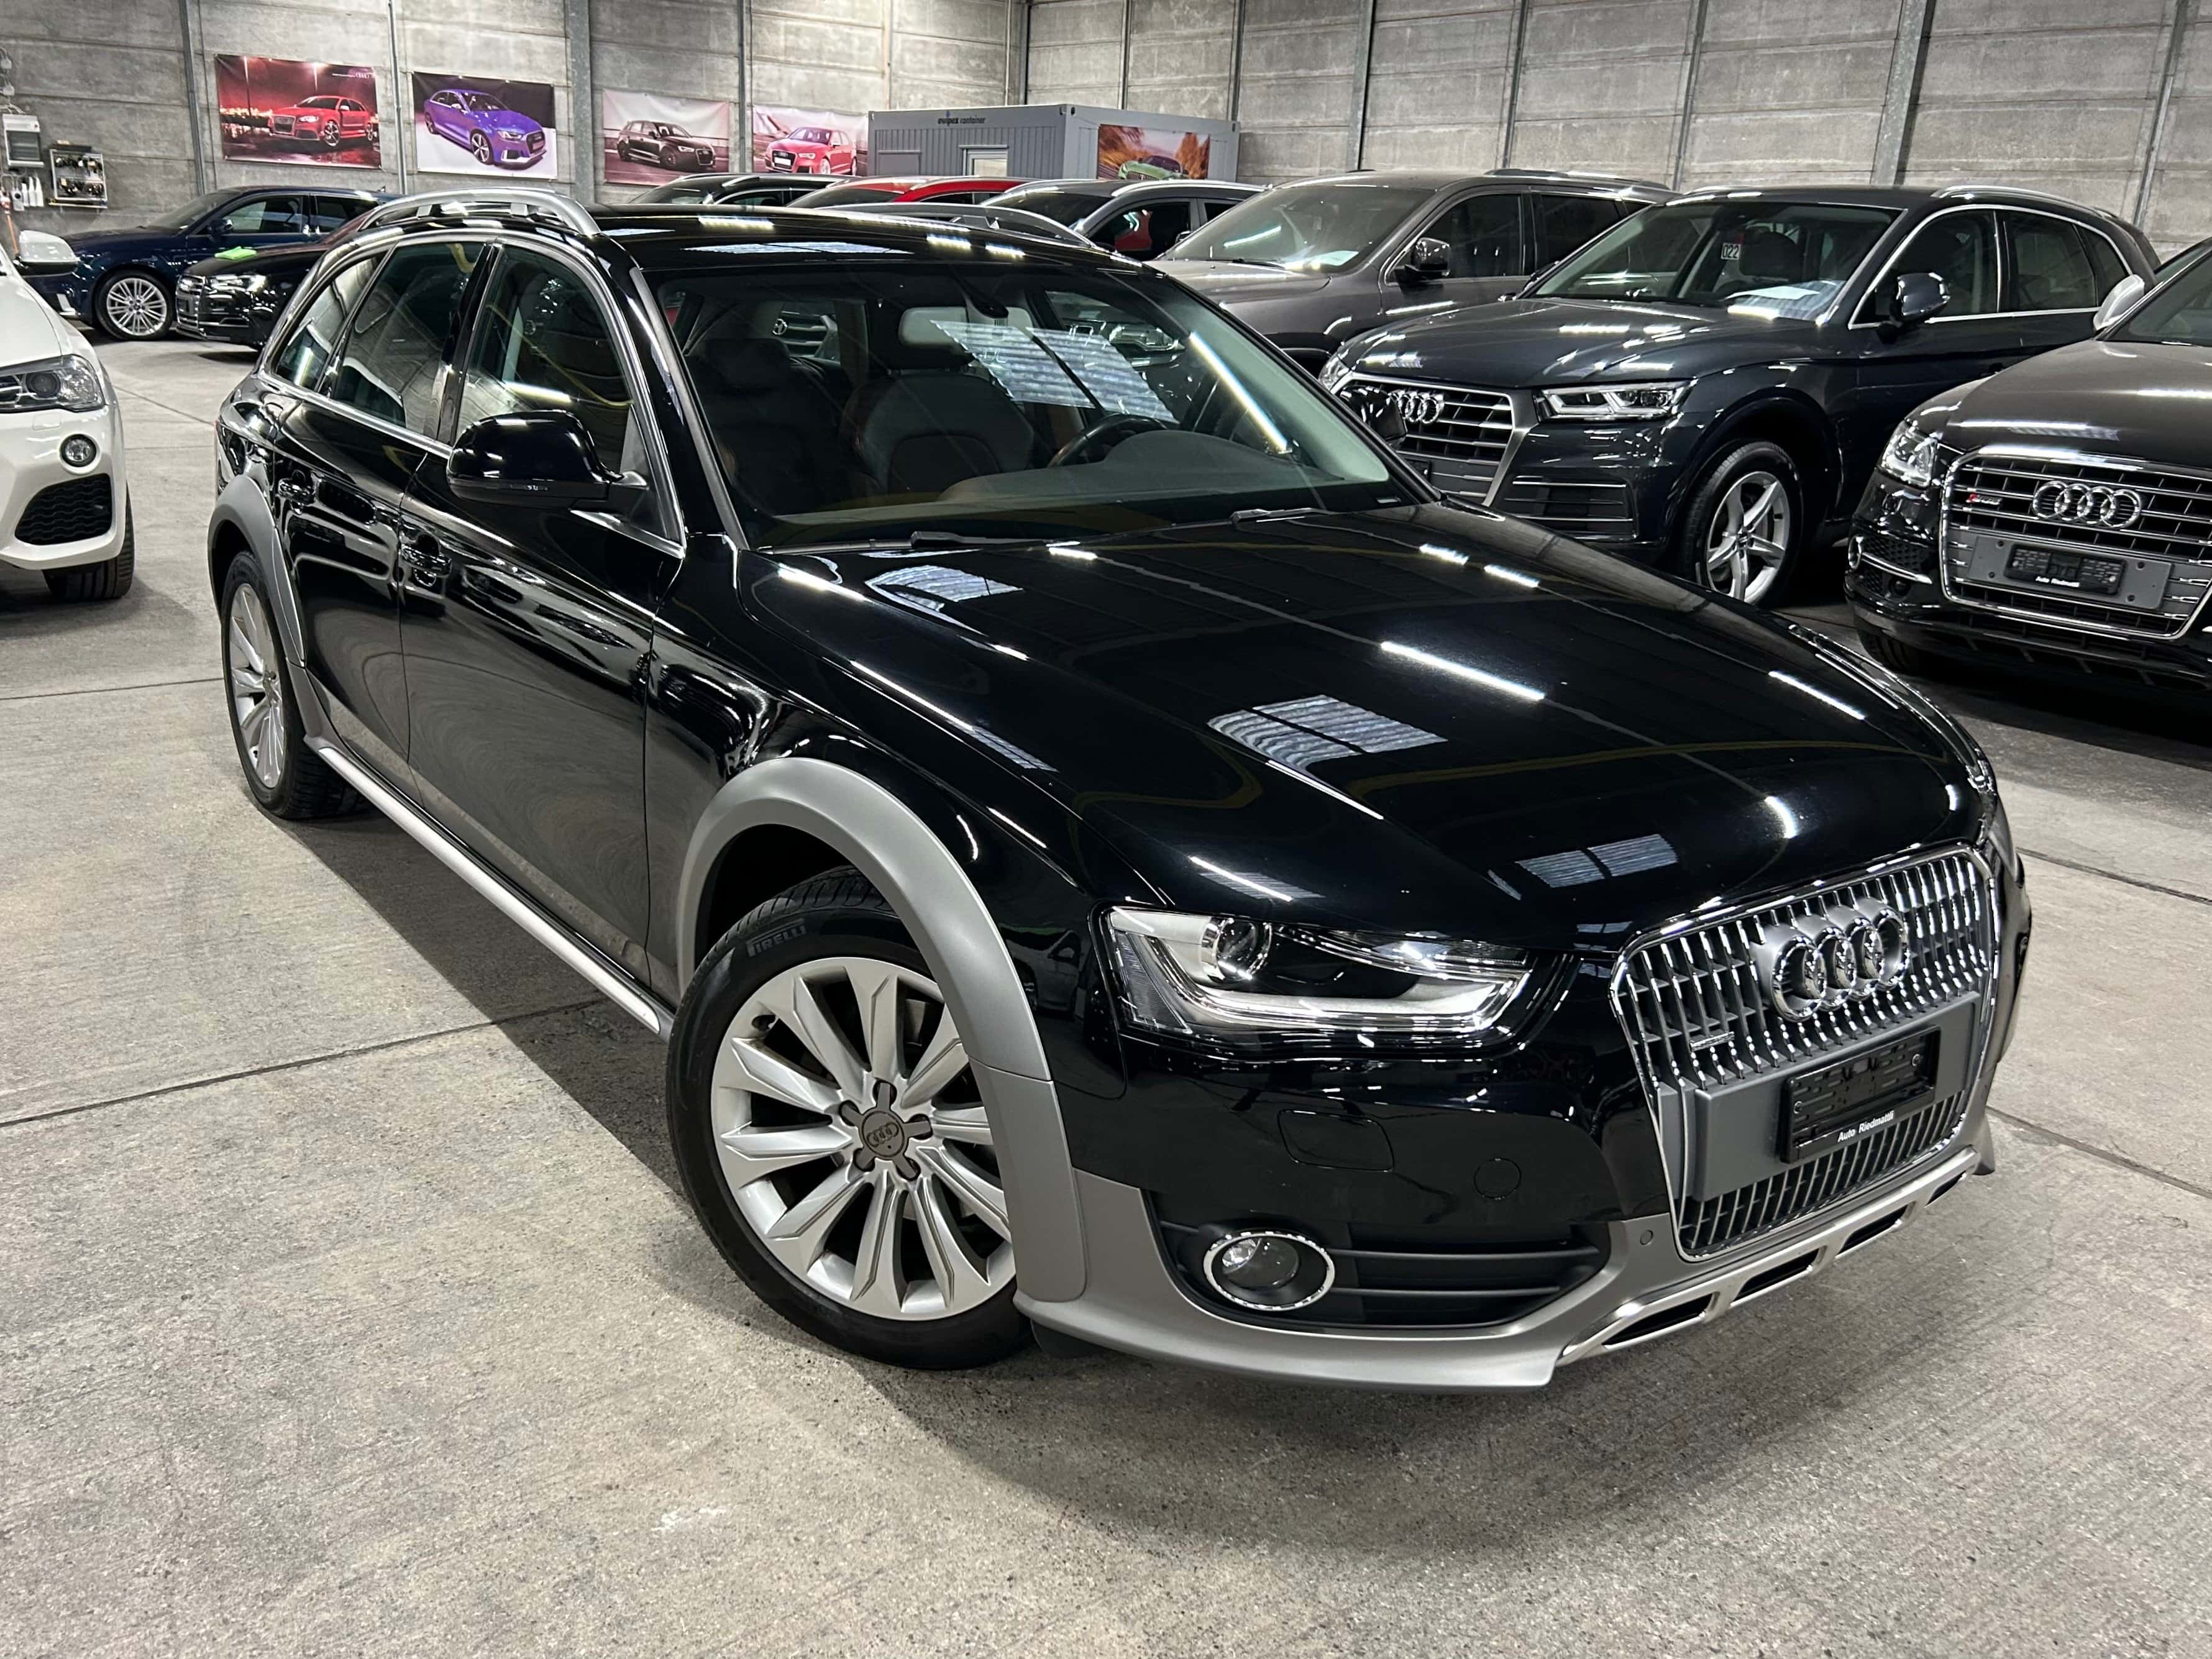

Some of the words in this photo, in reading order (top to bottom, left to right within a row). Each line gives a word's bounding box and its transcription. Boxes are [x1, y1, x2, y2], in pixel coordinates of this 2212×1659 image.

[1722, 244, 1739, 258] 022
[746, 918, 807, 957] PIRELLI
[1837, 1129, 1856, 1143] Auto
